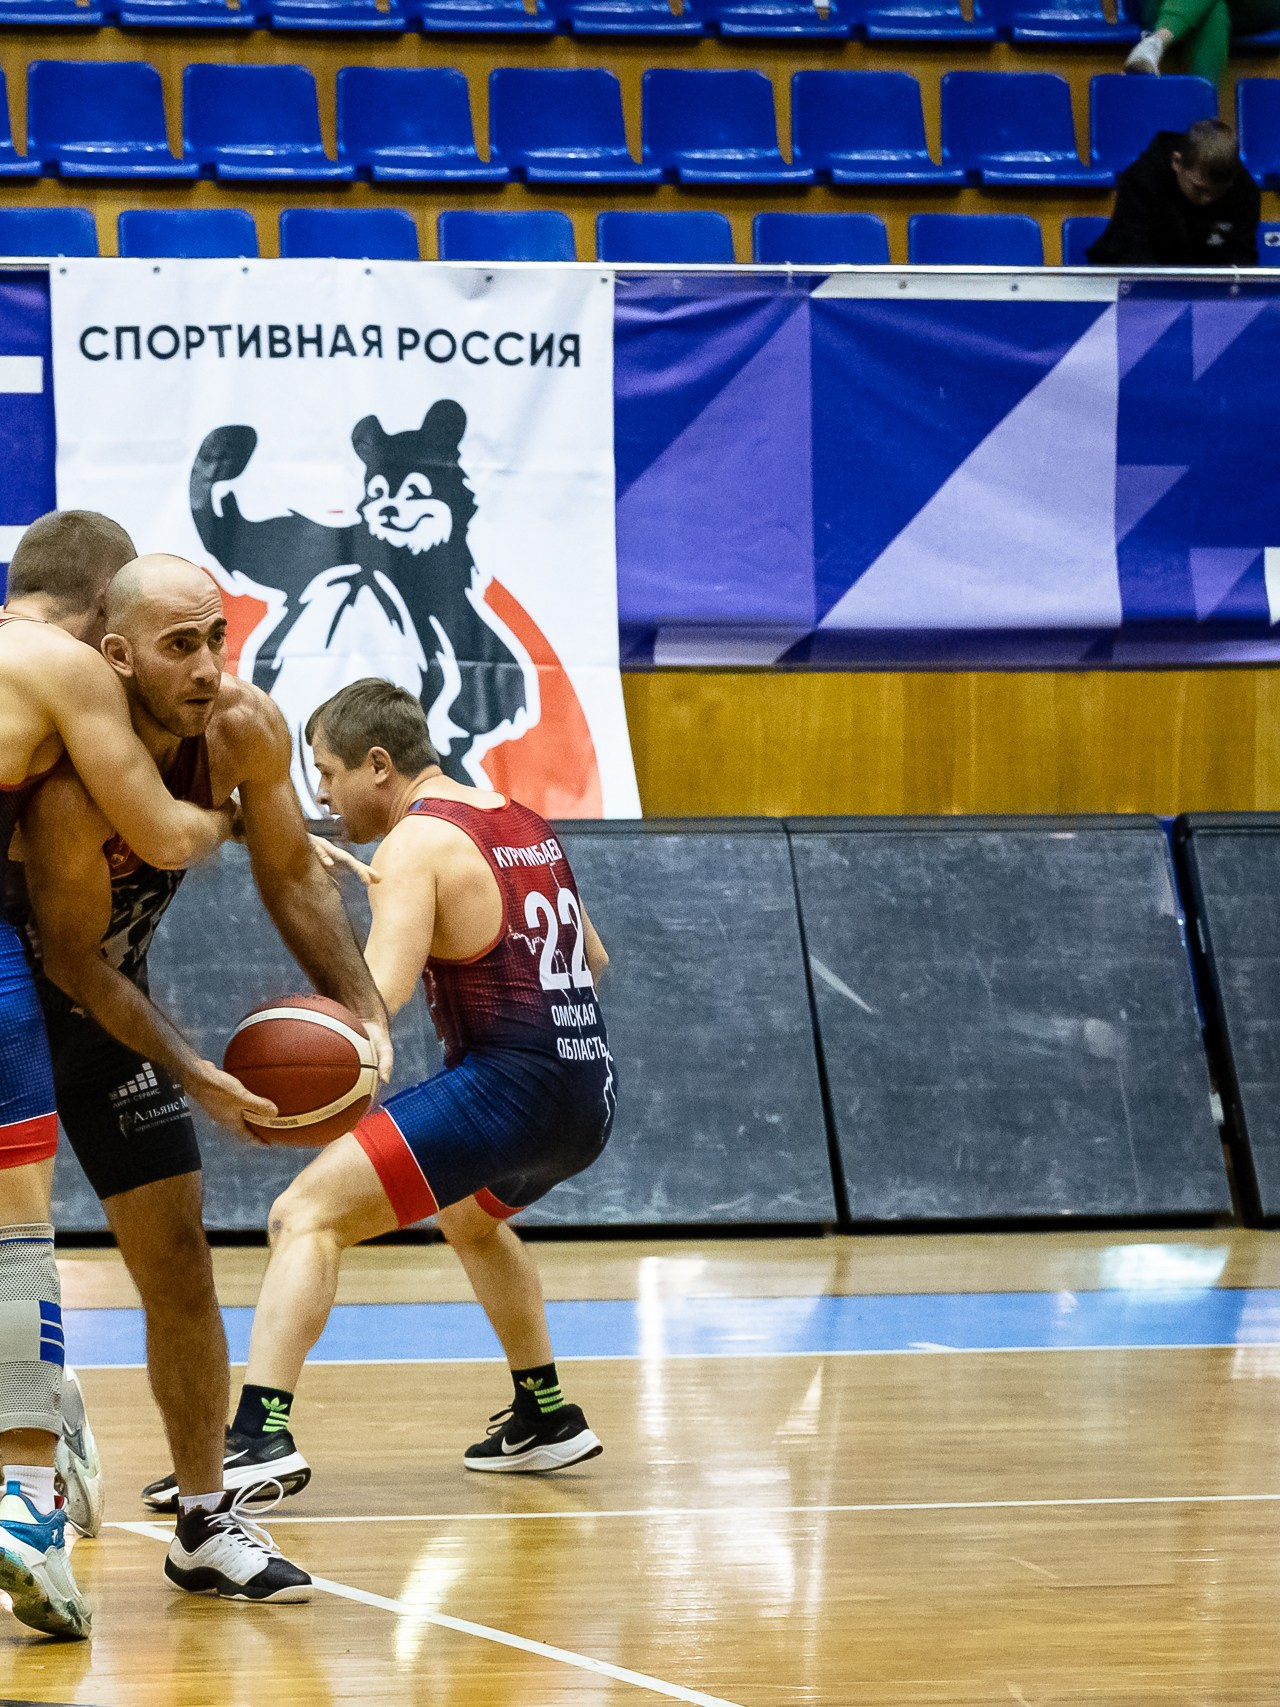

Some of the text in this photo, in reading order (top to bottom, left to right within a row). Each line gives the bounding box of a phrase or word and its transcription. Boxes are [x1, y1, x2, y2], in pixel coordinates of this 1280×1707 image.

[78, 323, 582, 369] СПОРТИВНАЯ РОССИЯ
[524, 887, 594, 991] 22
[551, 1003, 597, 1028] ОМСКАЯ
[556, 1037, 607, 1061] ОБЛАСТЬ
